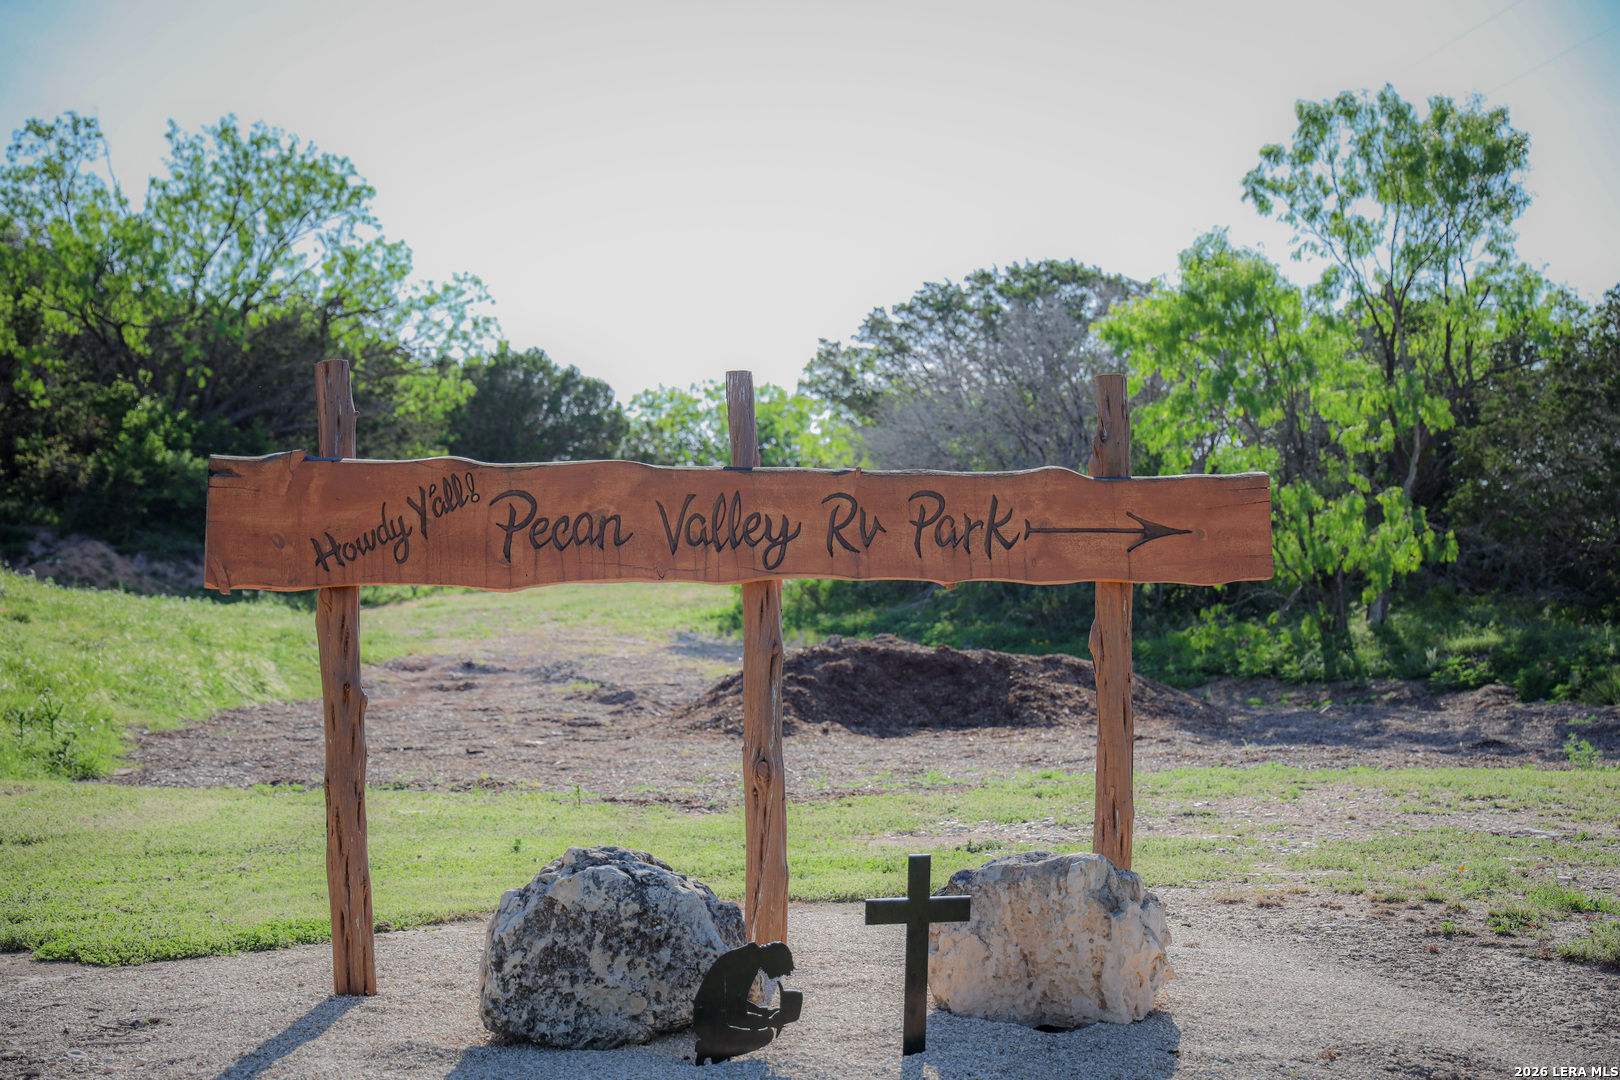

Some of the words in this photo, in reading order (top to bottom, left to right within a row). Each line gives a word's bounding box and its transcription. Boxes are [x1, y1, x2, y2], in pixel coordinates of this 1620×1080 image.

[310, 501, 413, 572] Howdy
[407, 472, 481, 540] Y'all!
[489, 489, 634, 564] Pecan
[655, 490, 802, 570] Valley
[908, 490, 1020, 560] Park
